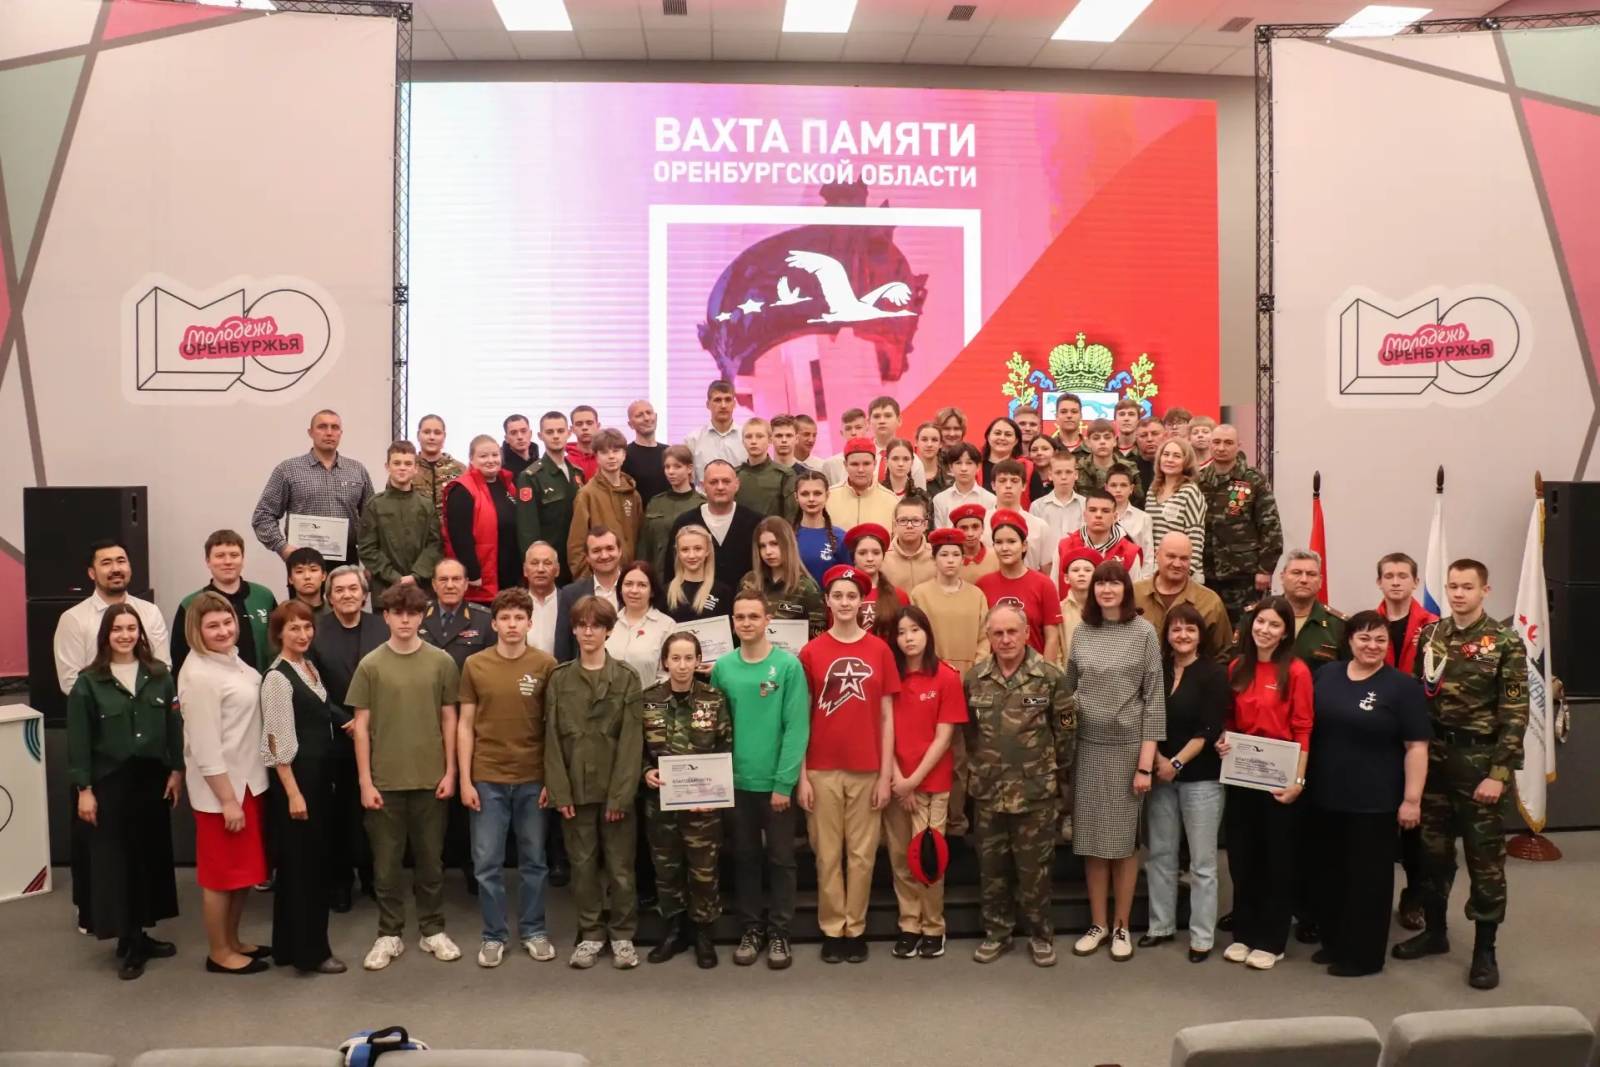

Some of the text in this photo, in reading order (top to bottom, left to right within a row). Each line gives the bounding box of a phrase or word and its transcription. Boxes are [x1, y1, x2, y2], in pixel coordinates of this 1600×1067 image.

[655, 116, 976, 157] ВАХТА ПАМЯТИ
[653, 159, 977, 187] ОРЕНБУРГСКОЙ ОБЛАСТИ
[183, 337, 300, 356] ОРЕНБУРЖЬЯ
[1382, 342, 1491, 362] ОРЕНБУРЖЬЯ
